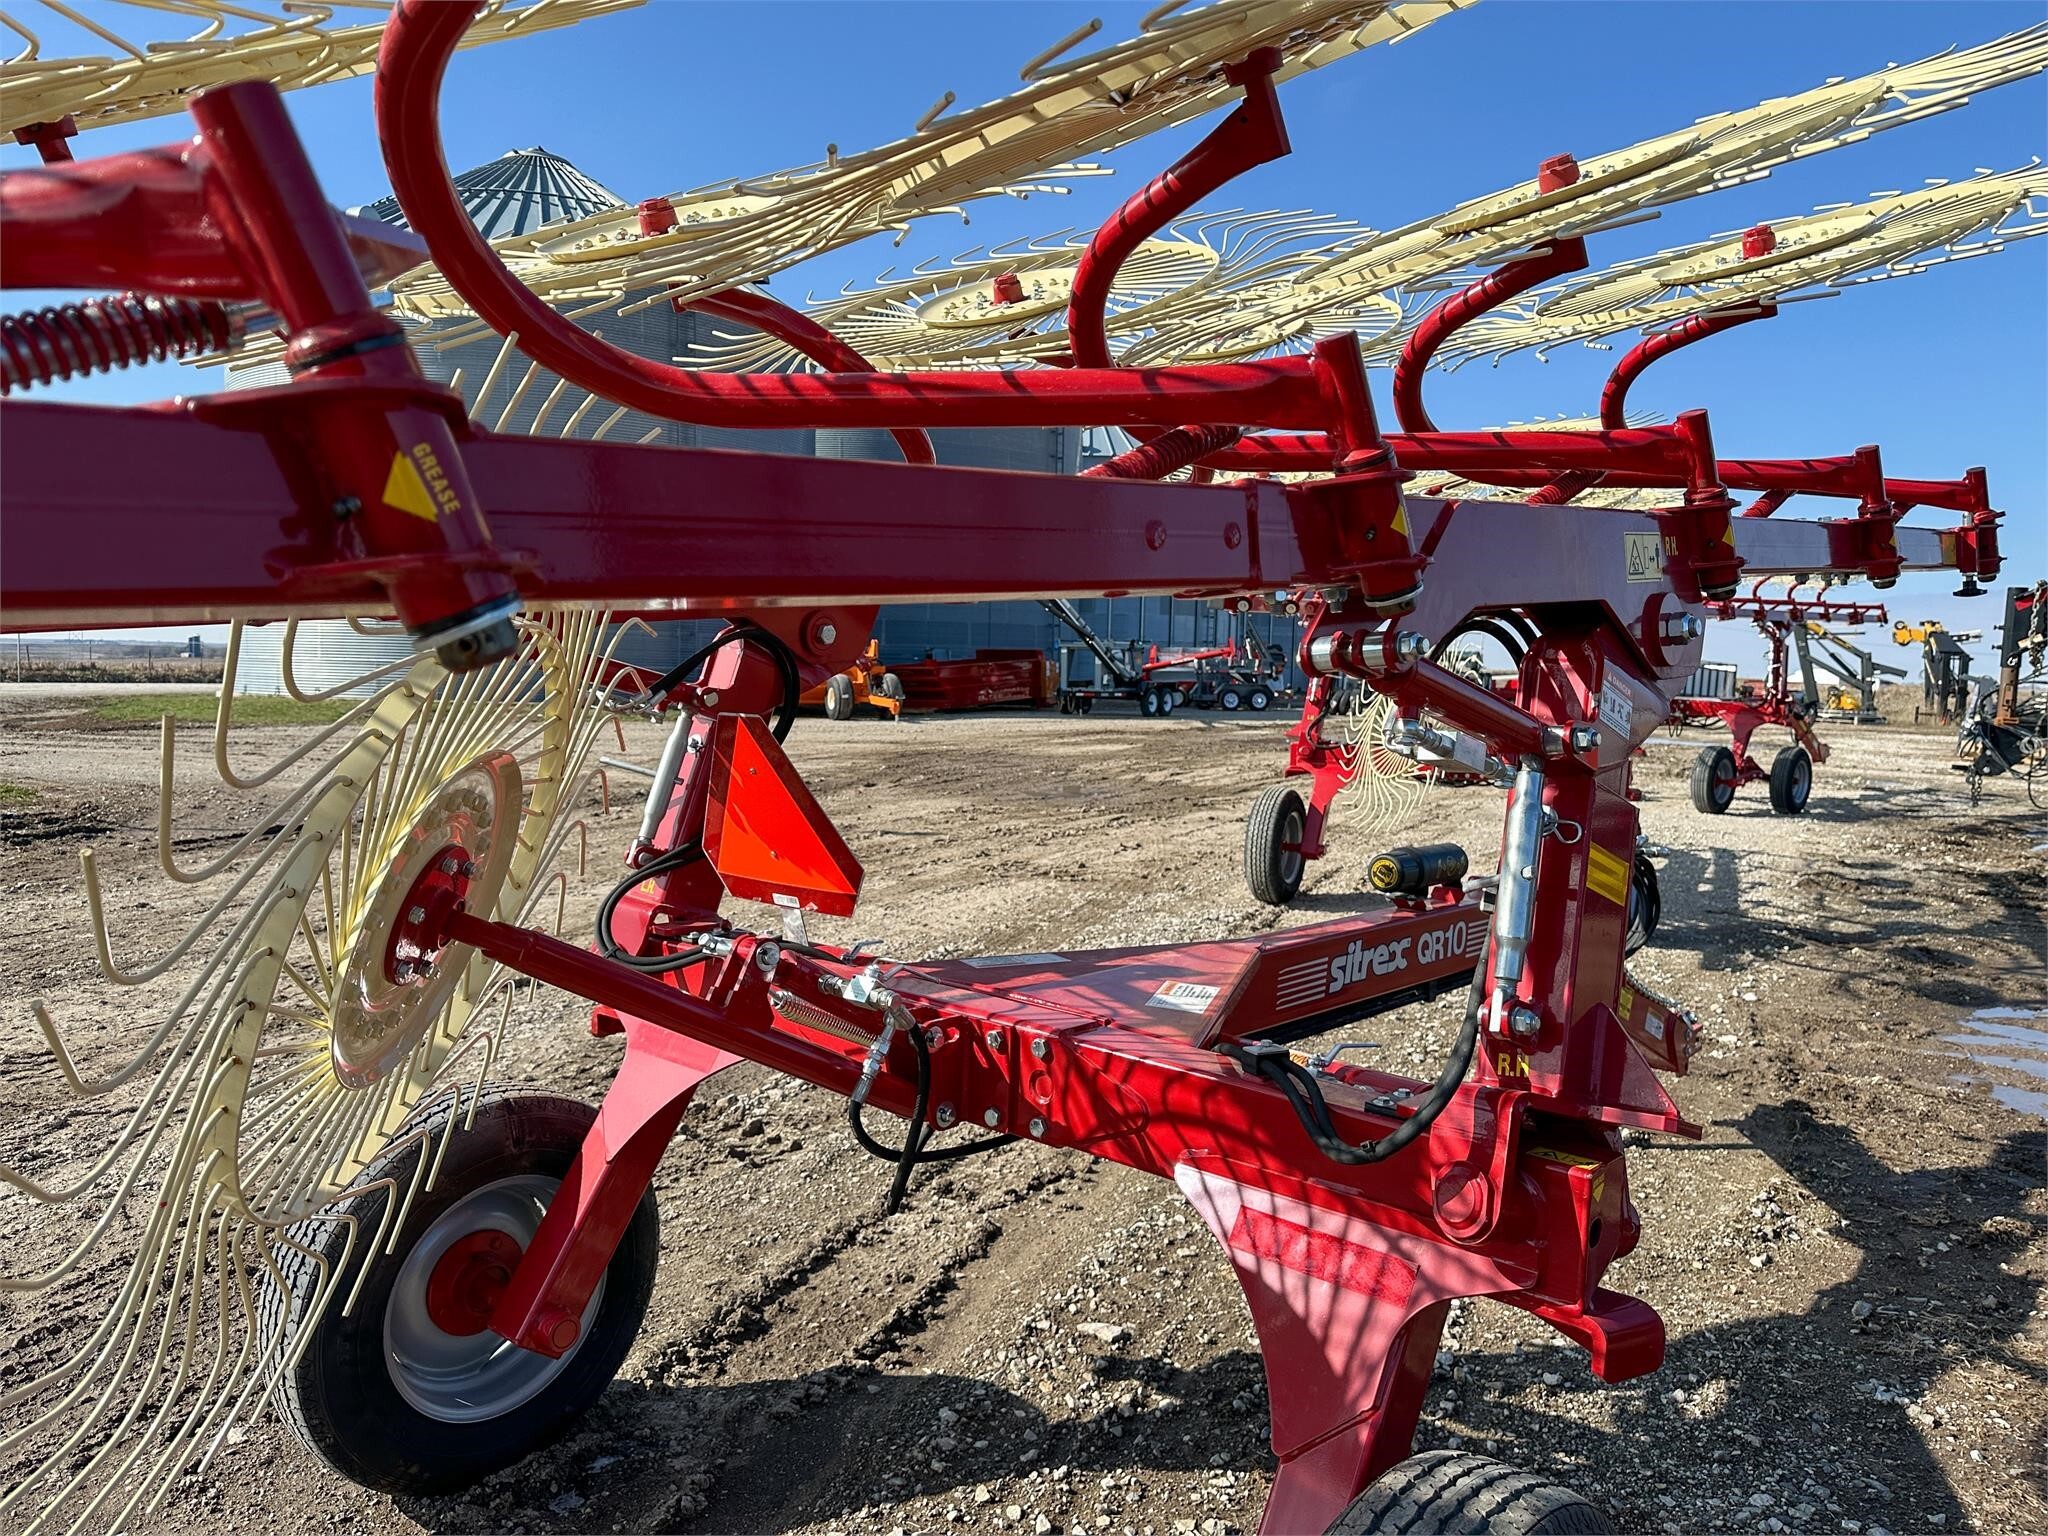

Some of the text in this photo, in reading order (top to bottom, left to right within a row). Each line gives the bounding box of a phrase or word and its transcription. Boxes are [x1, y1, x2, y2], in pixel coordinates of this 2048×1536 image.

[412, 443, 461, 515] GREASE
[1328, 920, 1467, 994] sitrex QR10
